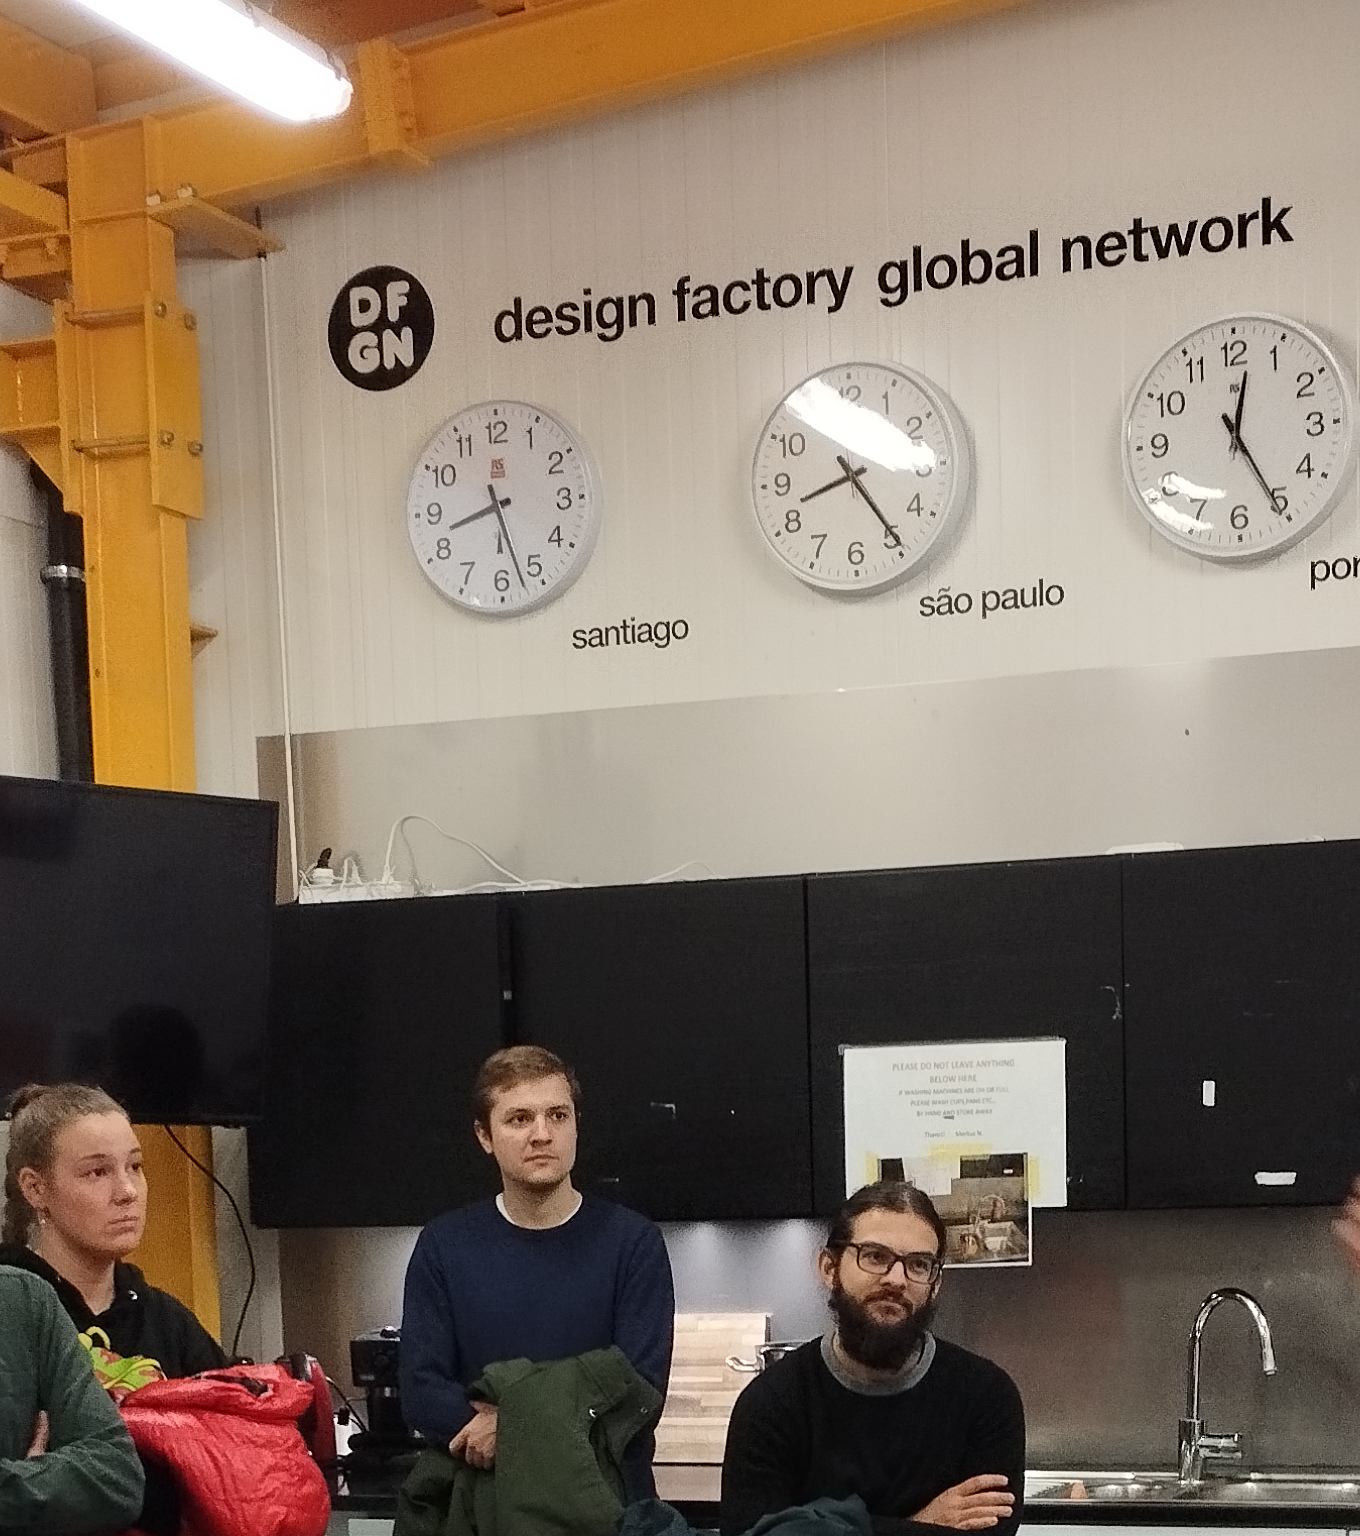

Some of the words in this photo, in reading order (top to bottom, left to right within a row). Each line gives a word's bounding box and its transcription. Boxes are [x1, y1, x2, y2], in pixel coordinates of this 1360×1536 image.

[493, 287, 656, 343] design
[671, 264, 854, 322] factory
[876, 228, 1041, 307] global
[1060, 196, 1294, 273] network
[348, 280, 411, 330] DF
[347, 325, 414, 374] GN
[1221, 340, 1247, 367] 12
[1270, 345, 1277, 372] 1
[1186, 356, 1204, 383] 11
[1296, 372, 1315, 398] 2
[1157, 391, 1185, 417] 10
[485, 420, 508, 444] 12
[1306, 411, 1325, 437] 3
[457, 434, 472, 458] 11
[526, 427, 532, 450] 1
[1151, 433, 1168, 458] 9
[548, 451, 564, 474] 2
[1296, 453, 1315, 479] 4
[432, 464, 456, 488] 10
[556, 487, 572, 510] 3
[1190, 498, 1207, 520] 7
[1271, 486, 1288, 515] 5
[427, 502, 442, 525] 9
[1230, 505, 1248, 530] 6
[548, 525, 564, 548] 4
[437, 538, 451, 560] 8
[460, 561, 475, 585] 7
[527, 554, 542, 577] 5
[494, 570, 510, 592] 6
[918, 585, 972, 618] são
[981, 579, 1064, 619] paulo
[571, 616, 690, 651] santiago
[892, 1063, 918, 1071] PLEASE
[921, 1062, 932, 1070] DO
[934, 1061, 949, 1070] NOT
[951, 1061, 974, 1069] LEAVE
[976, 1059, 1015, 1069] ANYTHING
[930, 1075, 957, 1084] BELOW
[958, 1074, 977, 1082] HERE
